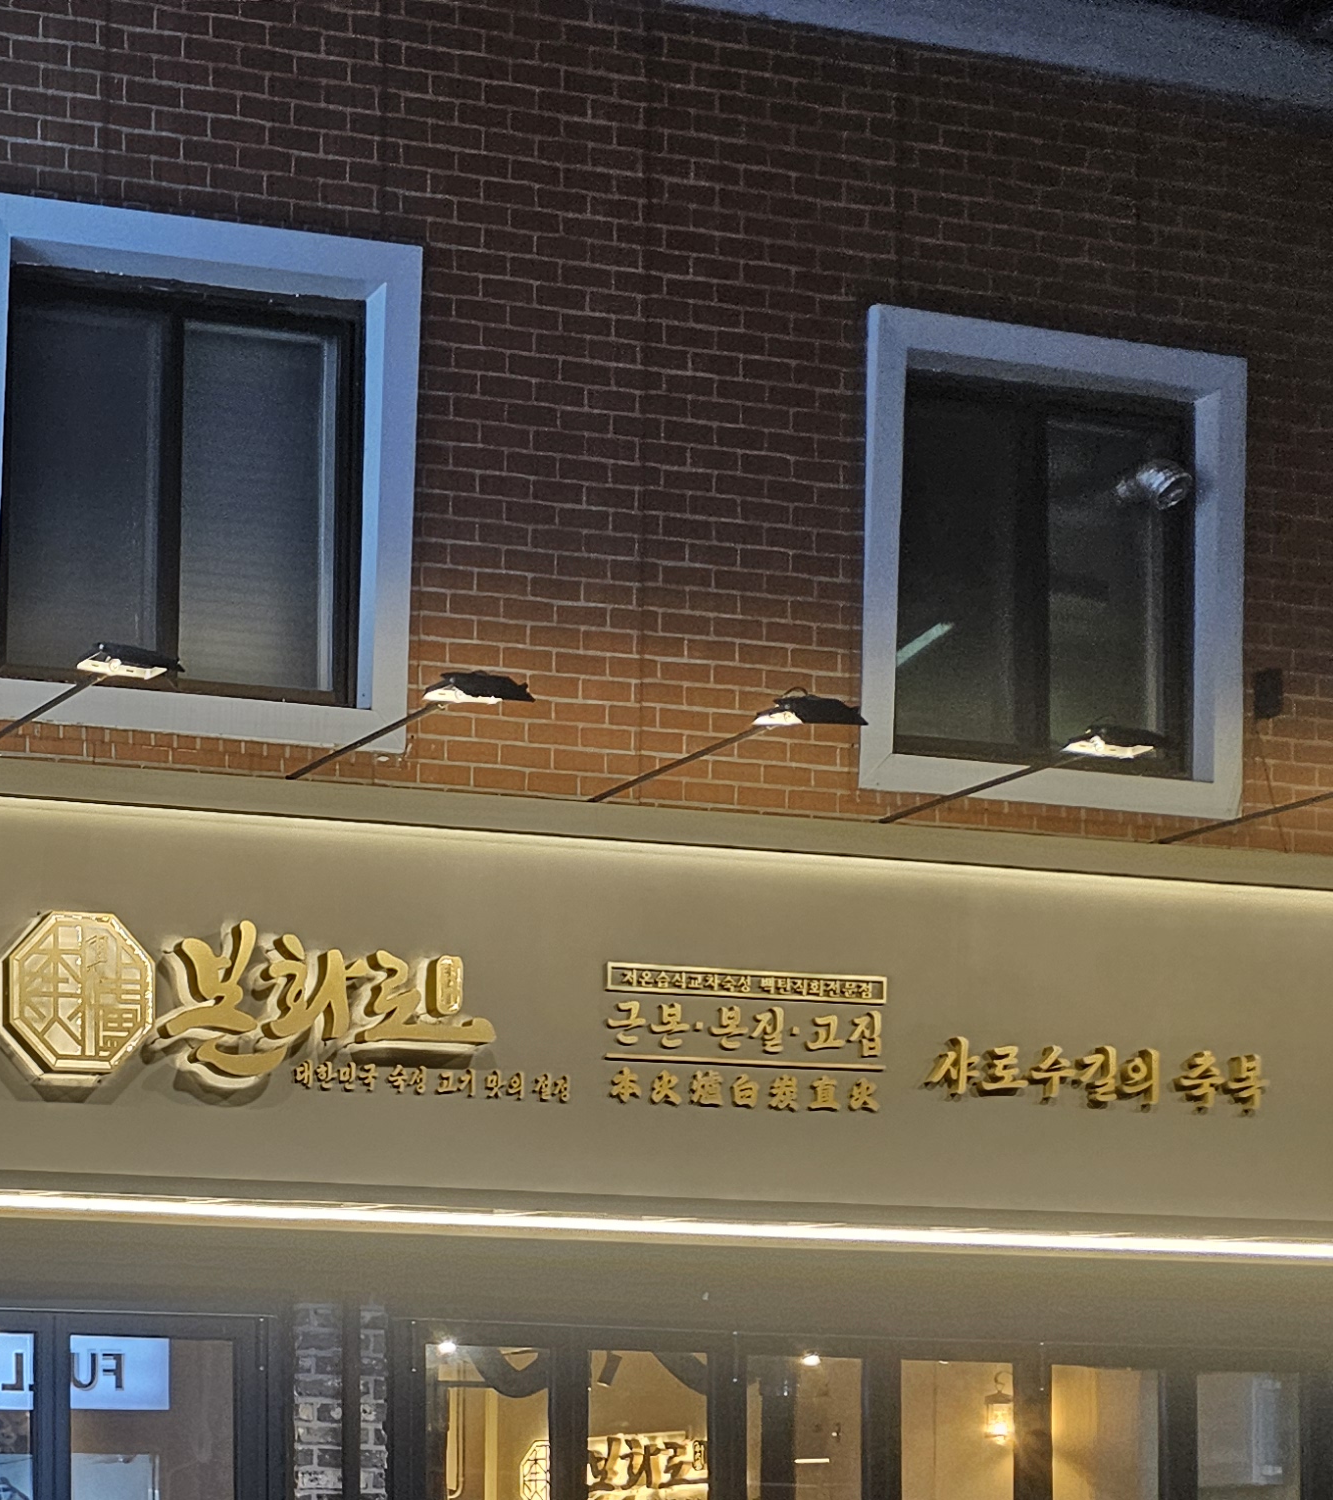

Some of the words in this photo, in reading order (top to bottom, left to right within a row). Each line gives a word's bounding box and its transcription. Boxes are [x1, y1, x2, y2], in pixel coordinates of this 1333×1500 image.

[158, 920, 496, 1077] 본화로
[622, 970, 752, 994] 저온습식교차숙성
[760, 977, 873, 997] 백탄직화전문점
[293, 1060, 378, 1091] 대한민국
[388, 1067, 426, 1095] 숙성
[436, 1068, 473, 1098] 고기
[486, 1070, 523, 1100] 맛의
[533, 1073, 573, 1103] 절정
[928, 1035, 1161, 1110] 샤로수길의
[1176, 1049, 1267, 1115] 축복
